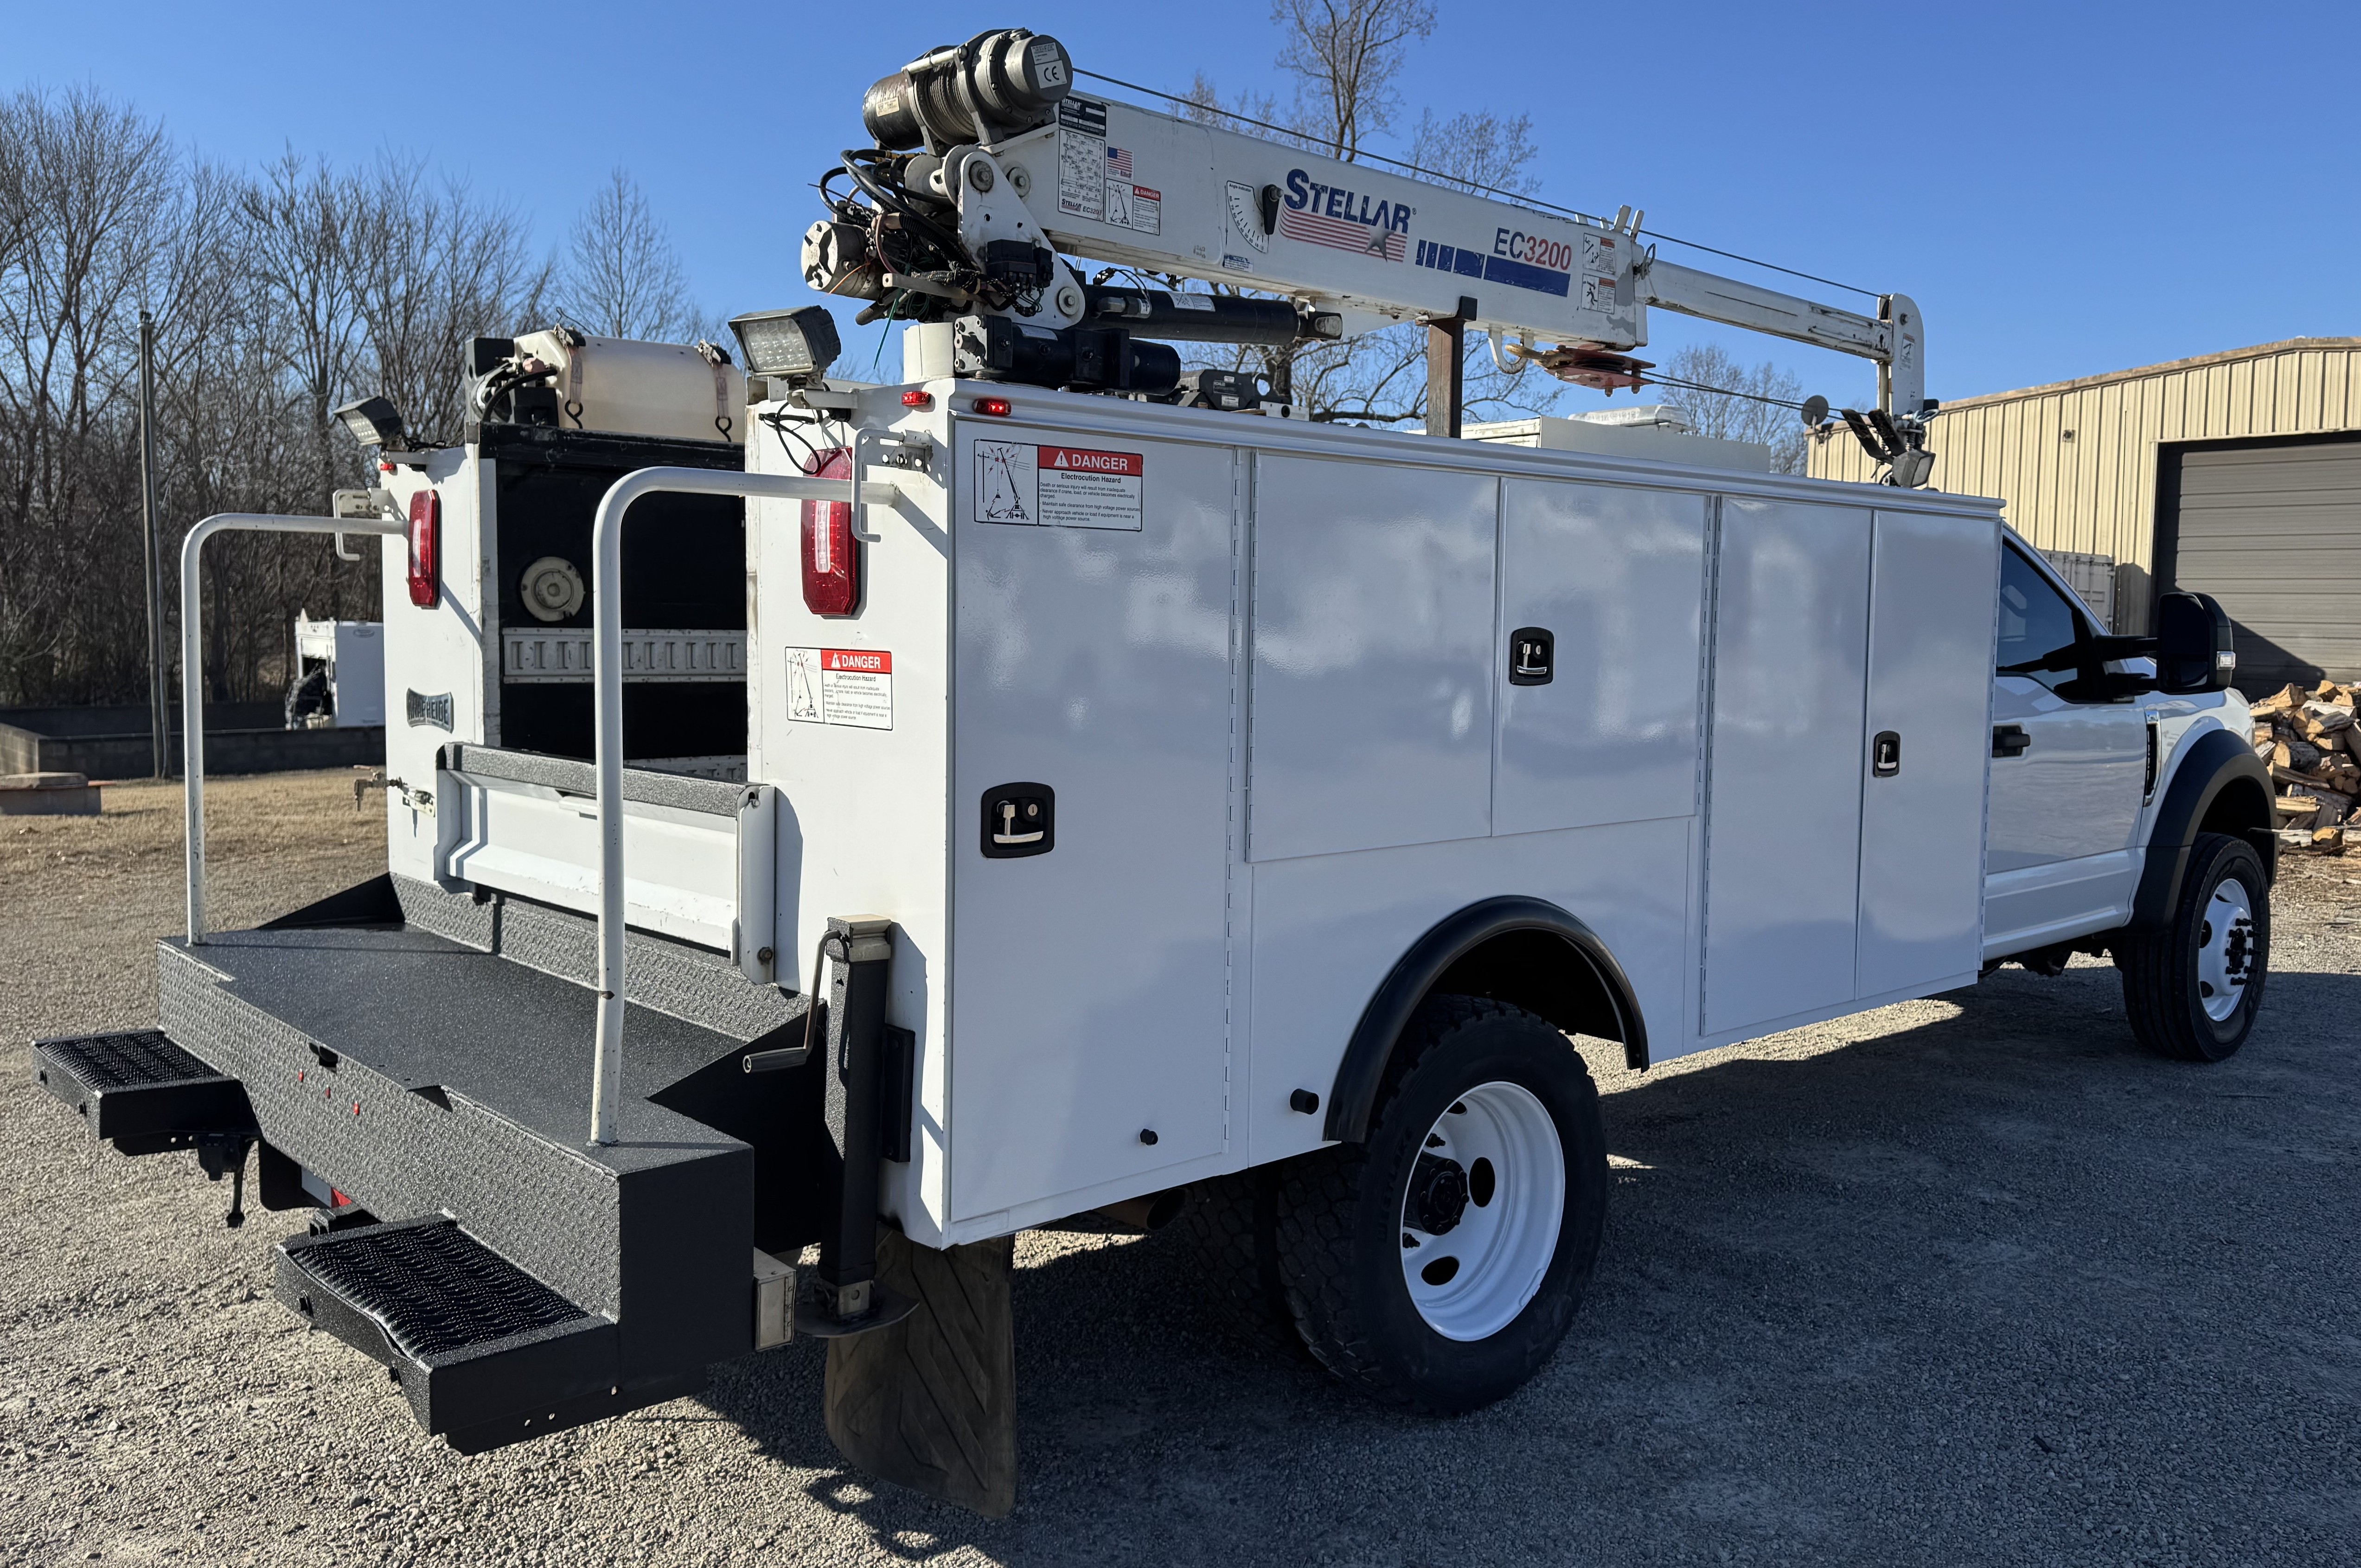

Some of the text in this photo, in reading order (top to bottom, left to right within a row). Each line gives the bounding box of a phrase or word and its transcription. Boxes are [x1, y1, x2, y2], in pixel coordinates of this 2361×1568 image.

[1044, 66, 1060, 82] CE
[1140, 190, 1159, 199] DANGER
[1062, 198, 1082, 209] STELLAR
[1494, 227, 1572, 270] EC3200
[1072, 454, 1128, 471] DANGER
[1061, 473, 1100, 481] Electrocution
[842, 654, 881, 669] DANGER
